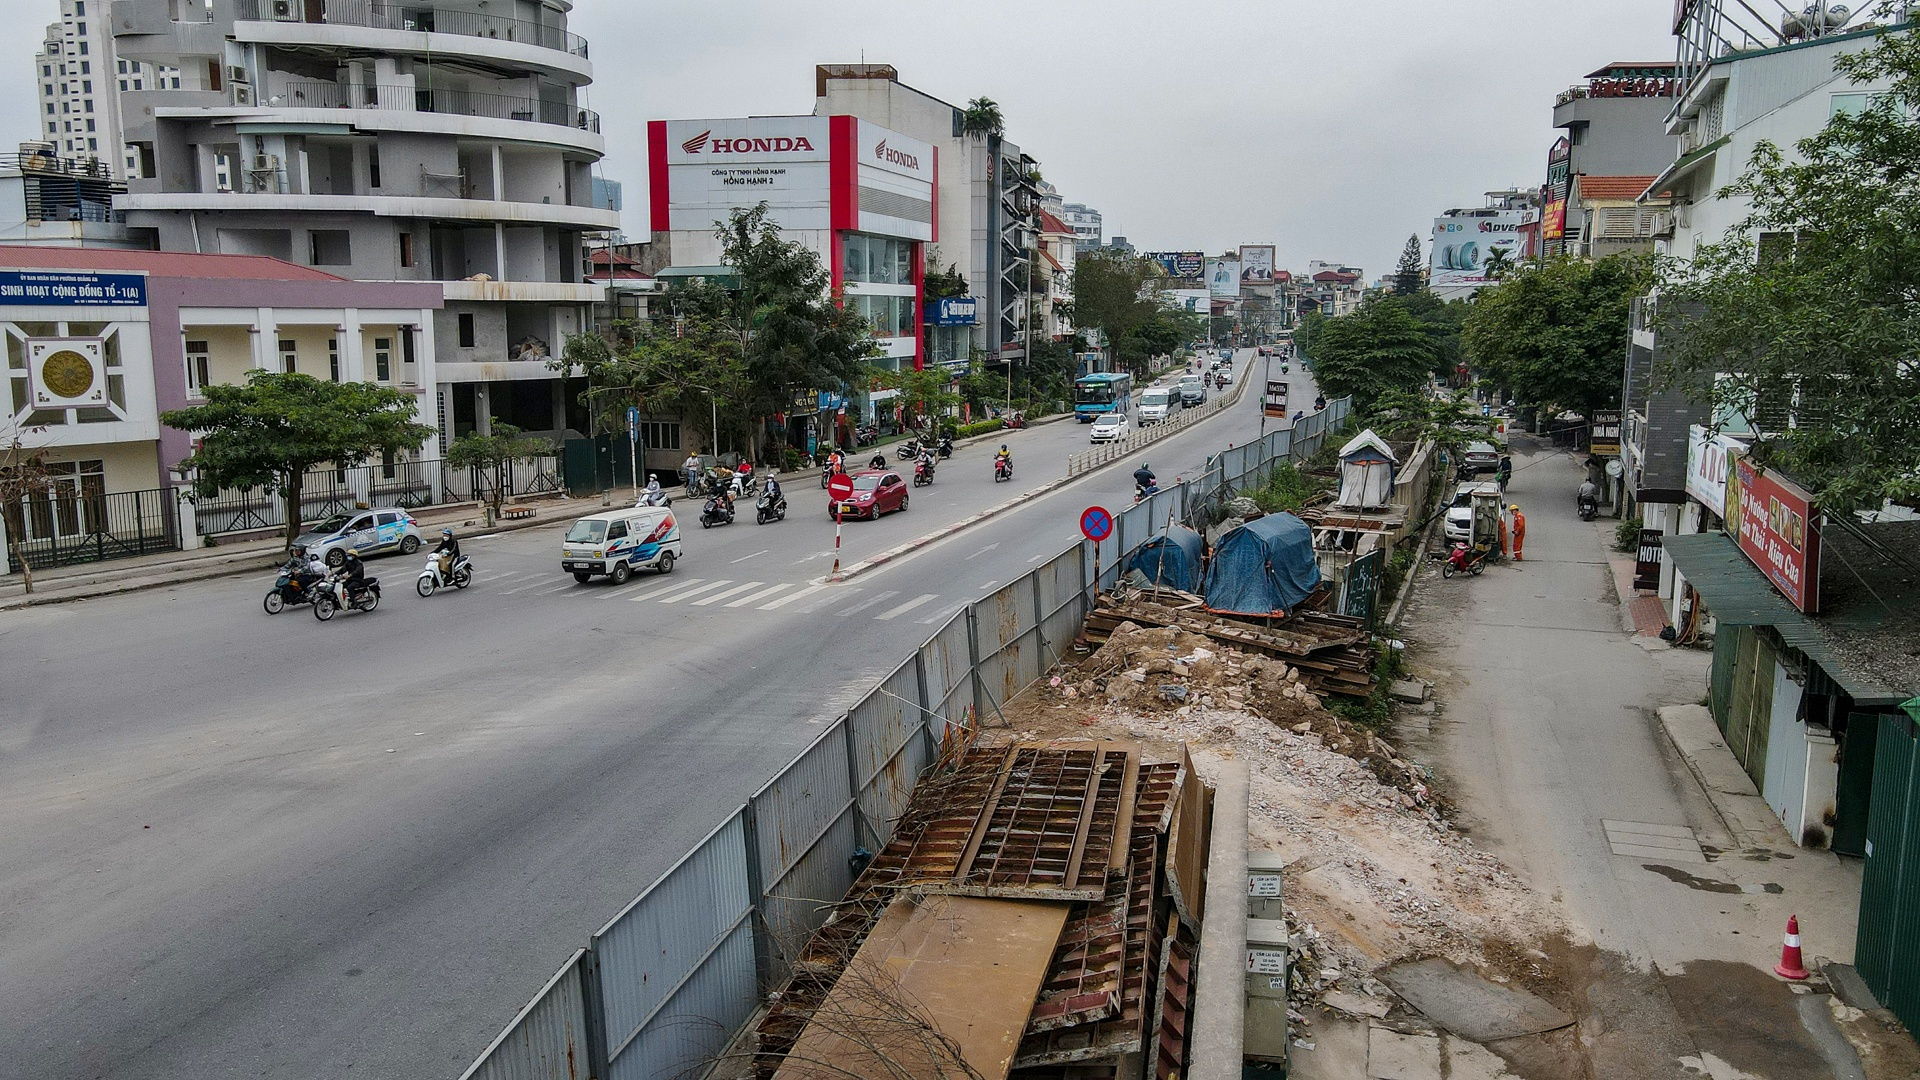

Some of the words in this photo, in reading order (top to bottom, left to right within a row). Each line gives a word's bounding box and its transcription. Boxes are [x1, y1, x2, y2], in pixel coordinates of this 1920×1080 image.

[711, 136, 815, 153] HONDA
[886, 147, 919, 170] HONDA
[746, 178, 768, 186] HẠNH
[1549, 166, 1567, 185] VIP
[1, 285, 24, 296] SINH
[26, 286, 49, 298] HOẠT
[52, 284, 77, 299] CỘNG
[79, 283, 103, 297] ĐỒNG
[105, 283, 116, 297] TỔ
[1700, 446, 1725, 488] ABC
[1741, 487, 1748, 508] Bò
[1751, 523, 1766, 551] Thái
[1768, 538, 1784, 570] Riêu
[1784, 554, 1799, 585] Cua
